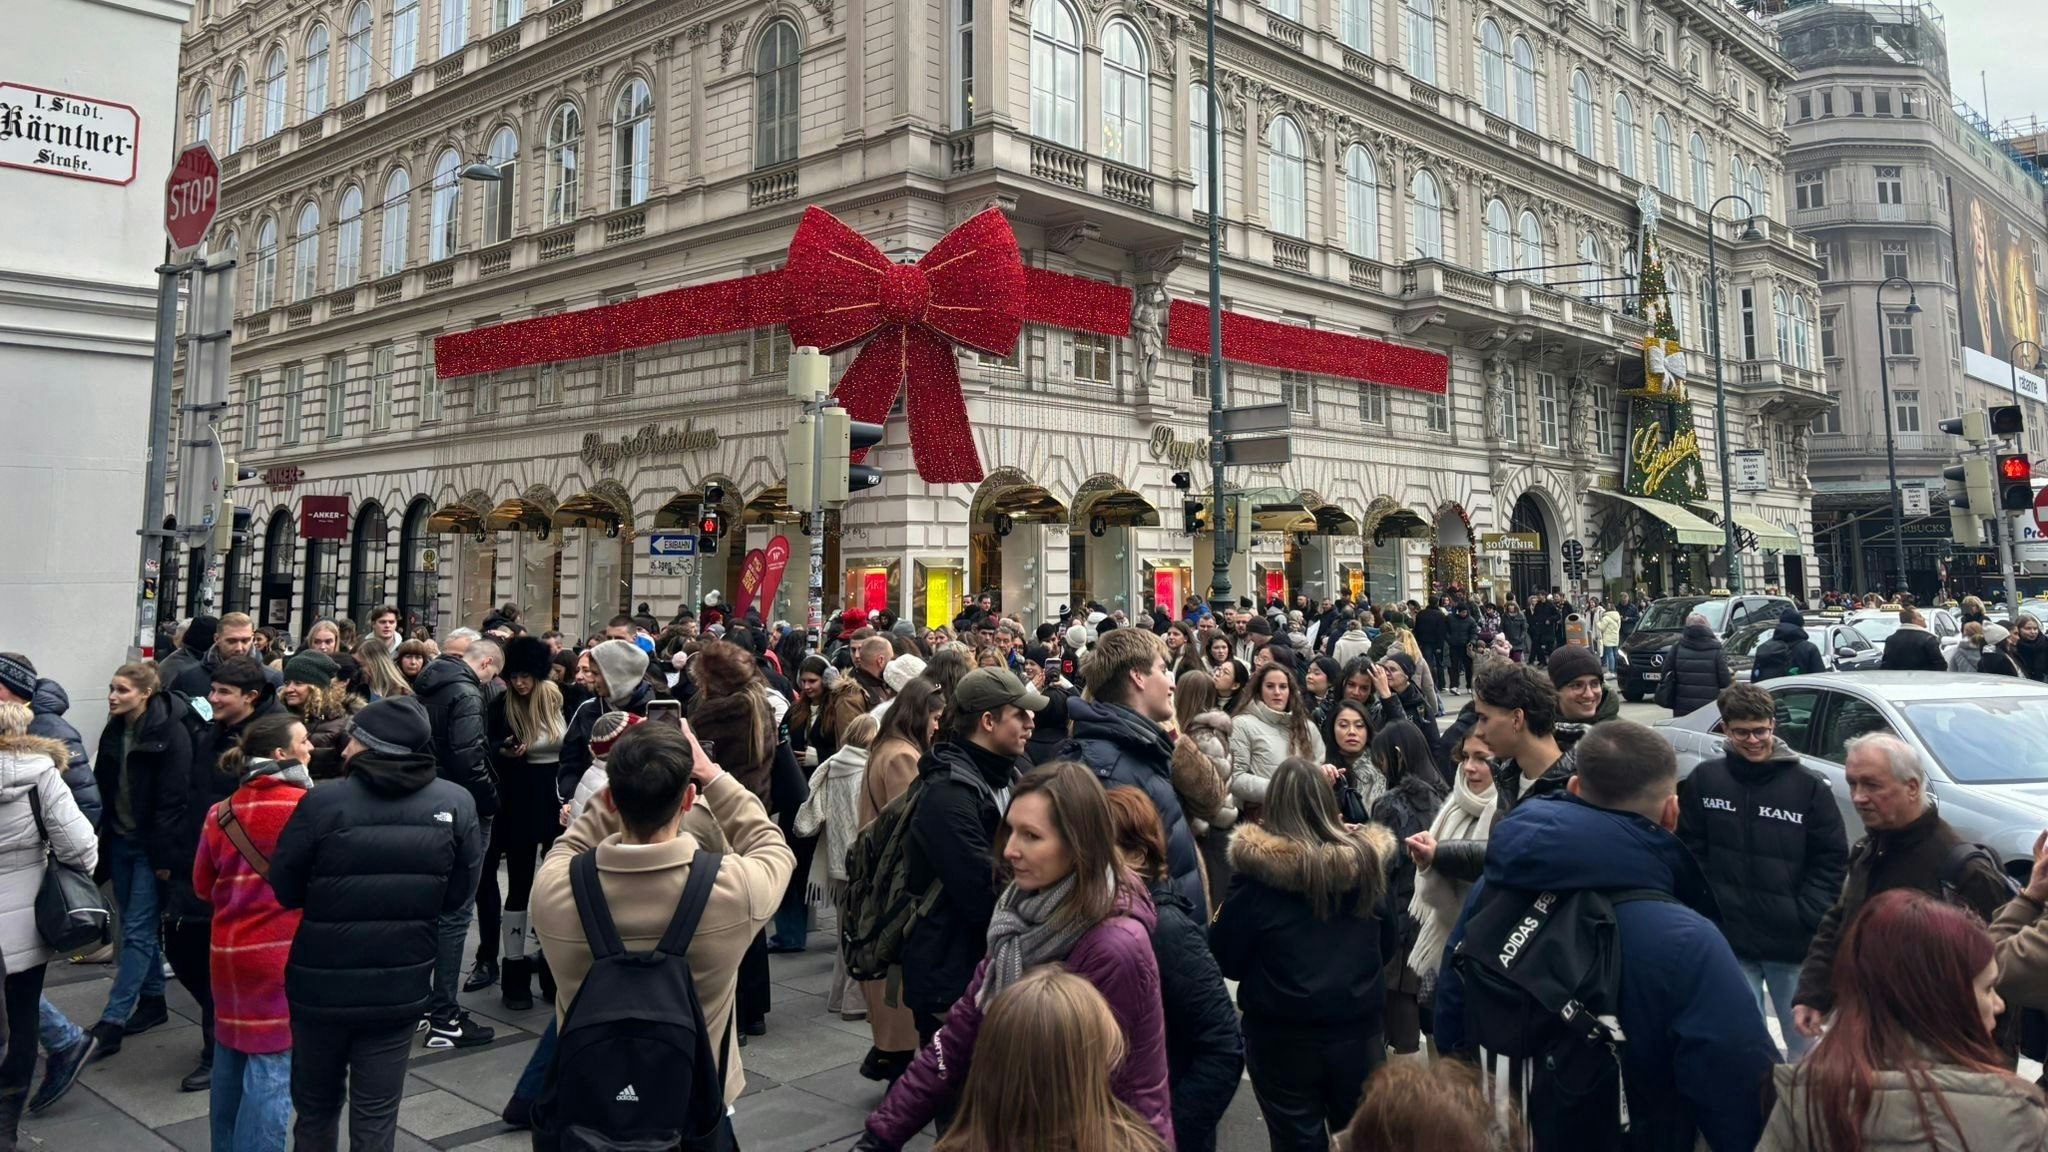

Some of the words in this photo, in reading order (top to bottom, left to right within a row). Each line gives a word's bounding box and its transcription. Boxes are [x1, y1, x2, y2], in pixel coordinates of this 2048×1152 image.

[48, 97, 103, 120] Stadt.
[33, 148, 91, 172] Straße.
[170, 176, 214, 221] STOP
[266, 467, 298, 484] ANKER
[313, 511, 339, 519] ANKER
[1485, 541, 1534, 549] SOUVENIR
[1702, 797, 1737, 812] KARL
[1758, 805, 1803, 824] KANI
[1498, 916, 1539, 969] ADIDAS
[616, 1094, 639, 1102] adidas
